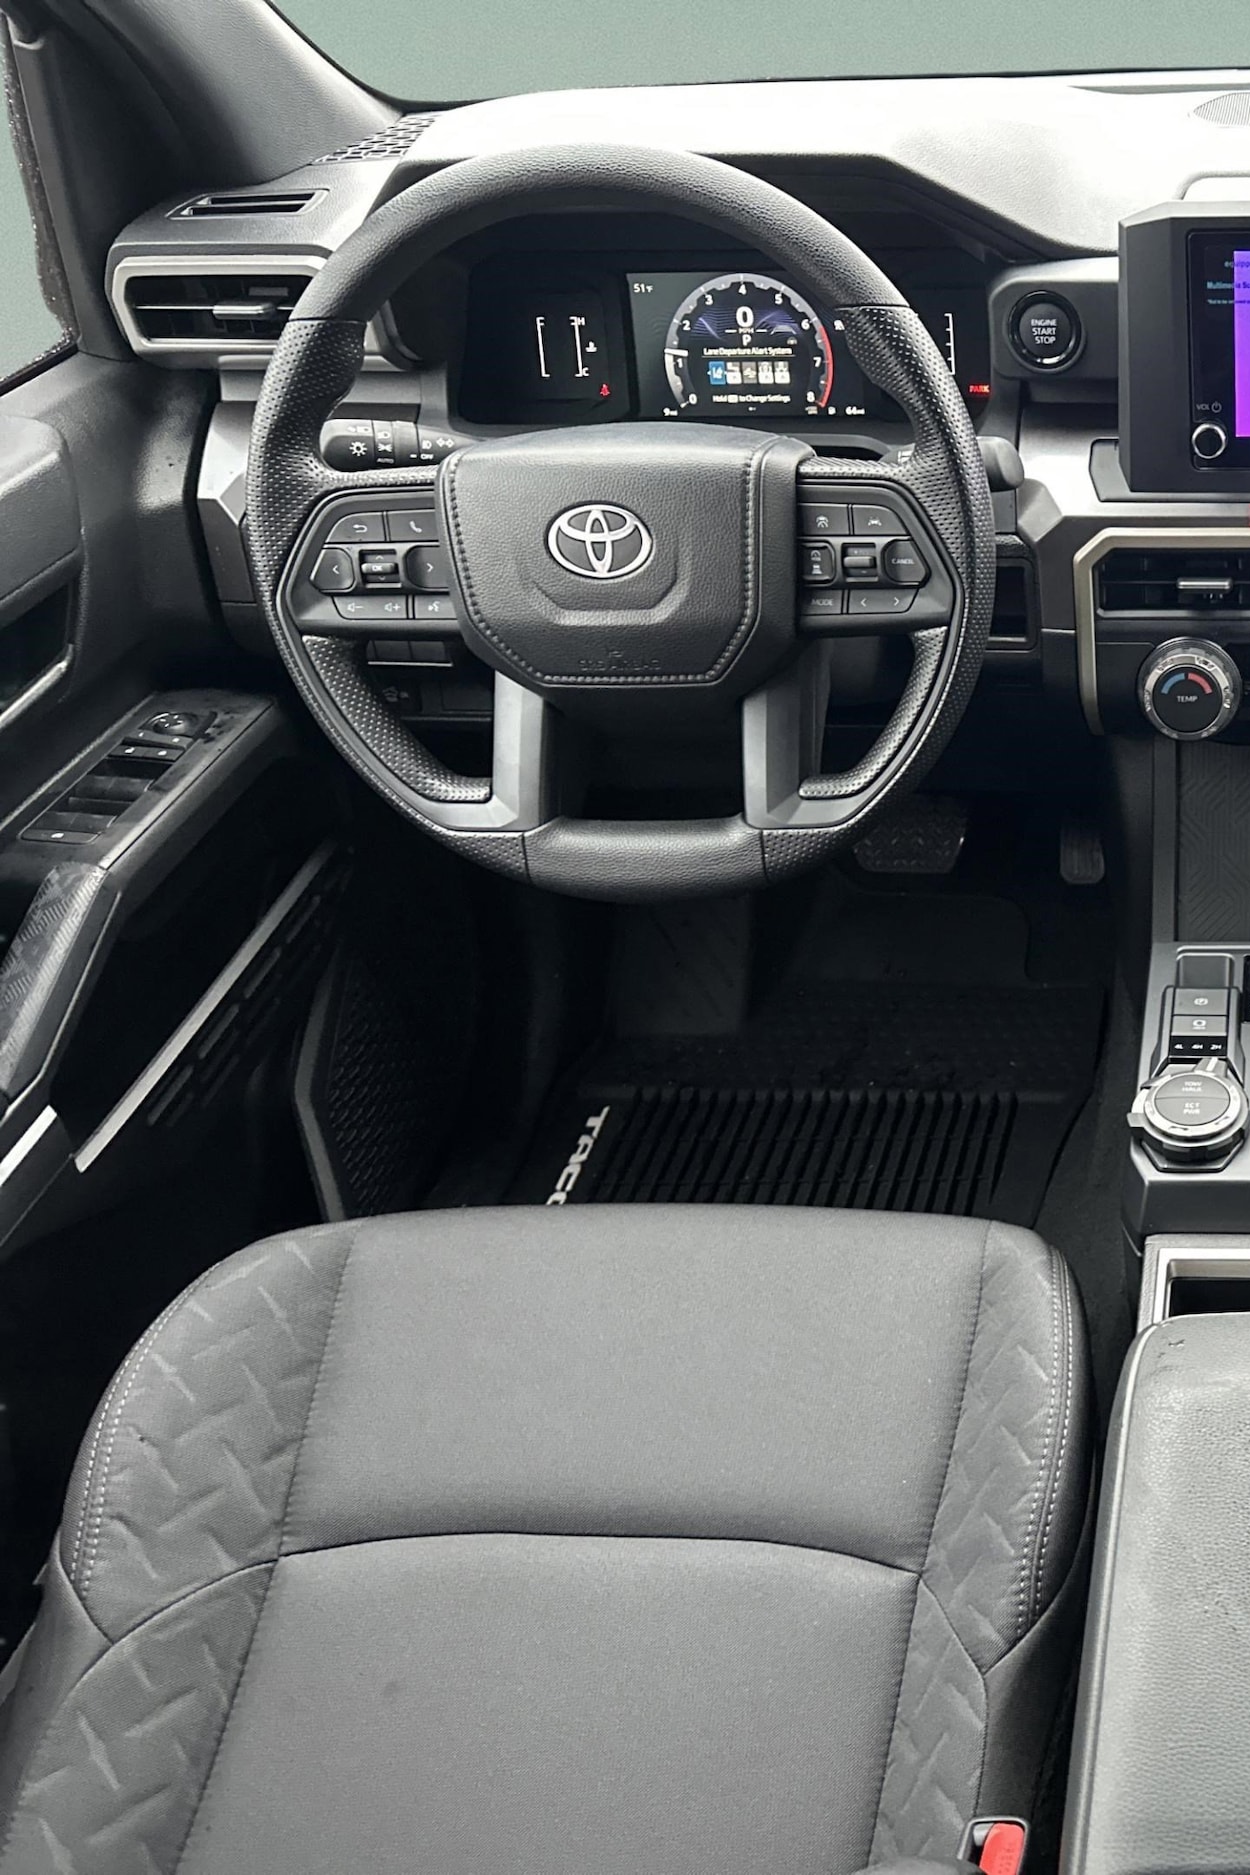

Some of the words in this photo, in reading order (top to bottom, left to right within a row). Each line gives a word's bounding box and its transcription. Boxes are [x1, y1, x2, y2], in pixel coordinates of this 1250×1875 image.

[738, 286, 747, 295] 4
[705, 295, 714, 305] 3
[774, 295, 783, 305] 5
[735, 306, 754, 328] 0
[682, 322, 691, 331] 2
[801, 321, 810, 330] 6
[1030, 318, 1057, 327] ENGINE
[1032, 327, 1057, 336] START
[742, 334, 752, 346] P
[1035, 336, 1057, 345] STOP
[677, 359, 683, 368] 1
[813, 358, 822, 367] 7
[689, 394, 698, 404] 0
[807, 391, 816, 402] 8
[1176, 695, 1198, 703] TEMP
